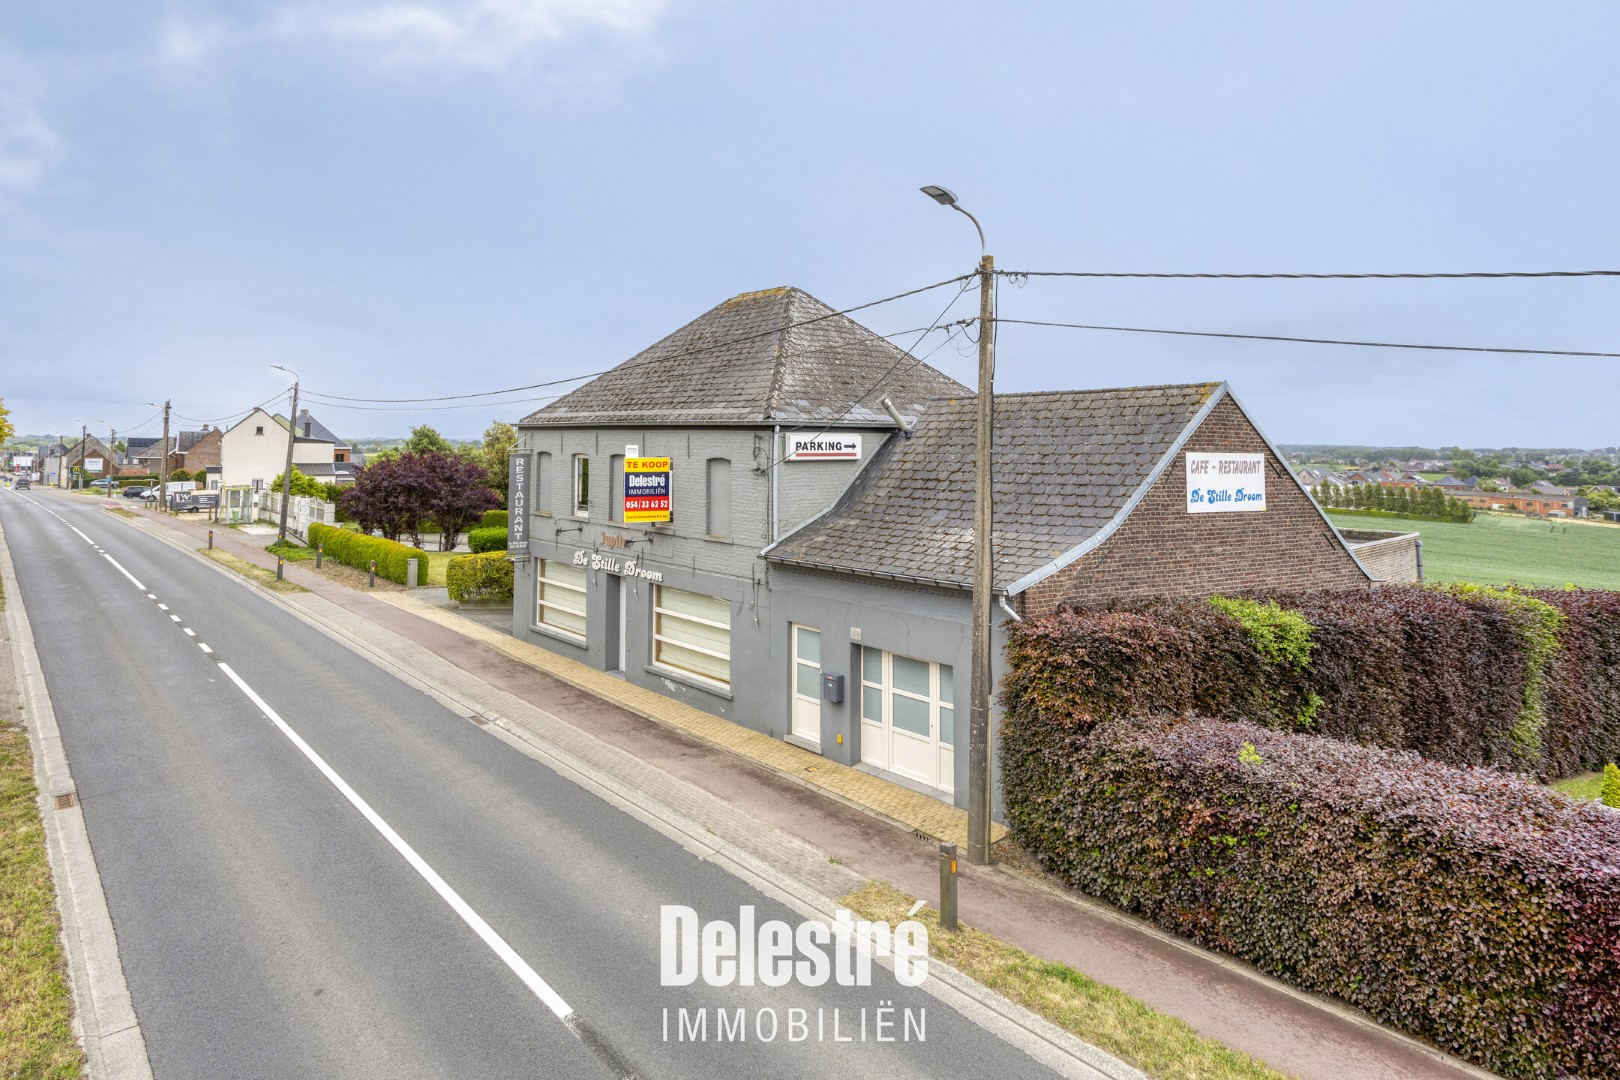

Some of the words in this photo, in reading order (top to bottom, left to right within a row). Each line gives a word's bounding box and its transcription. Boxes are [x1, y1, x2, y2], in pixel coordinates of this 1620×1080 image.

[795, 441, 843, 451] PARKING
[1190, 460, 1209, 474] CAFE
[1219, 460, 1260, 474] RESTAURANT
[629, 474, 665, 487] Delestré
[514, 458, 524, 540] RESTAURANT
[1190, 488, 1204, 503] De
[1207, 490, 1232, 504] Stille
[1235, 488, 1262, 502] Droom
[626, 500, 649, 509] 054/33
[573, 550, 588, 566] De
[592, 554, 620, 572] Stille
[624, 560, 663, 582] Droom
